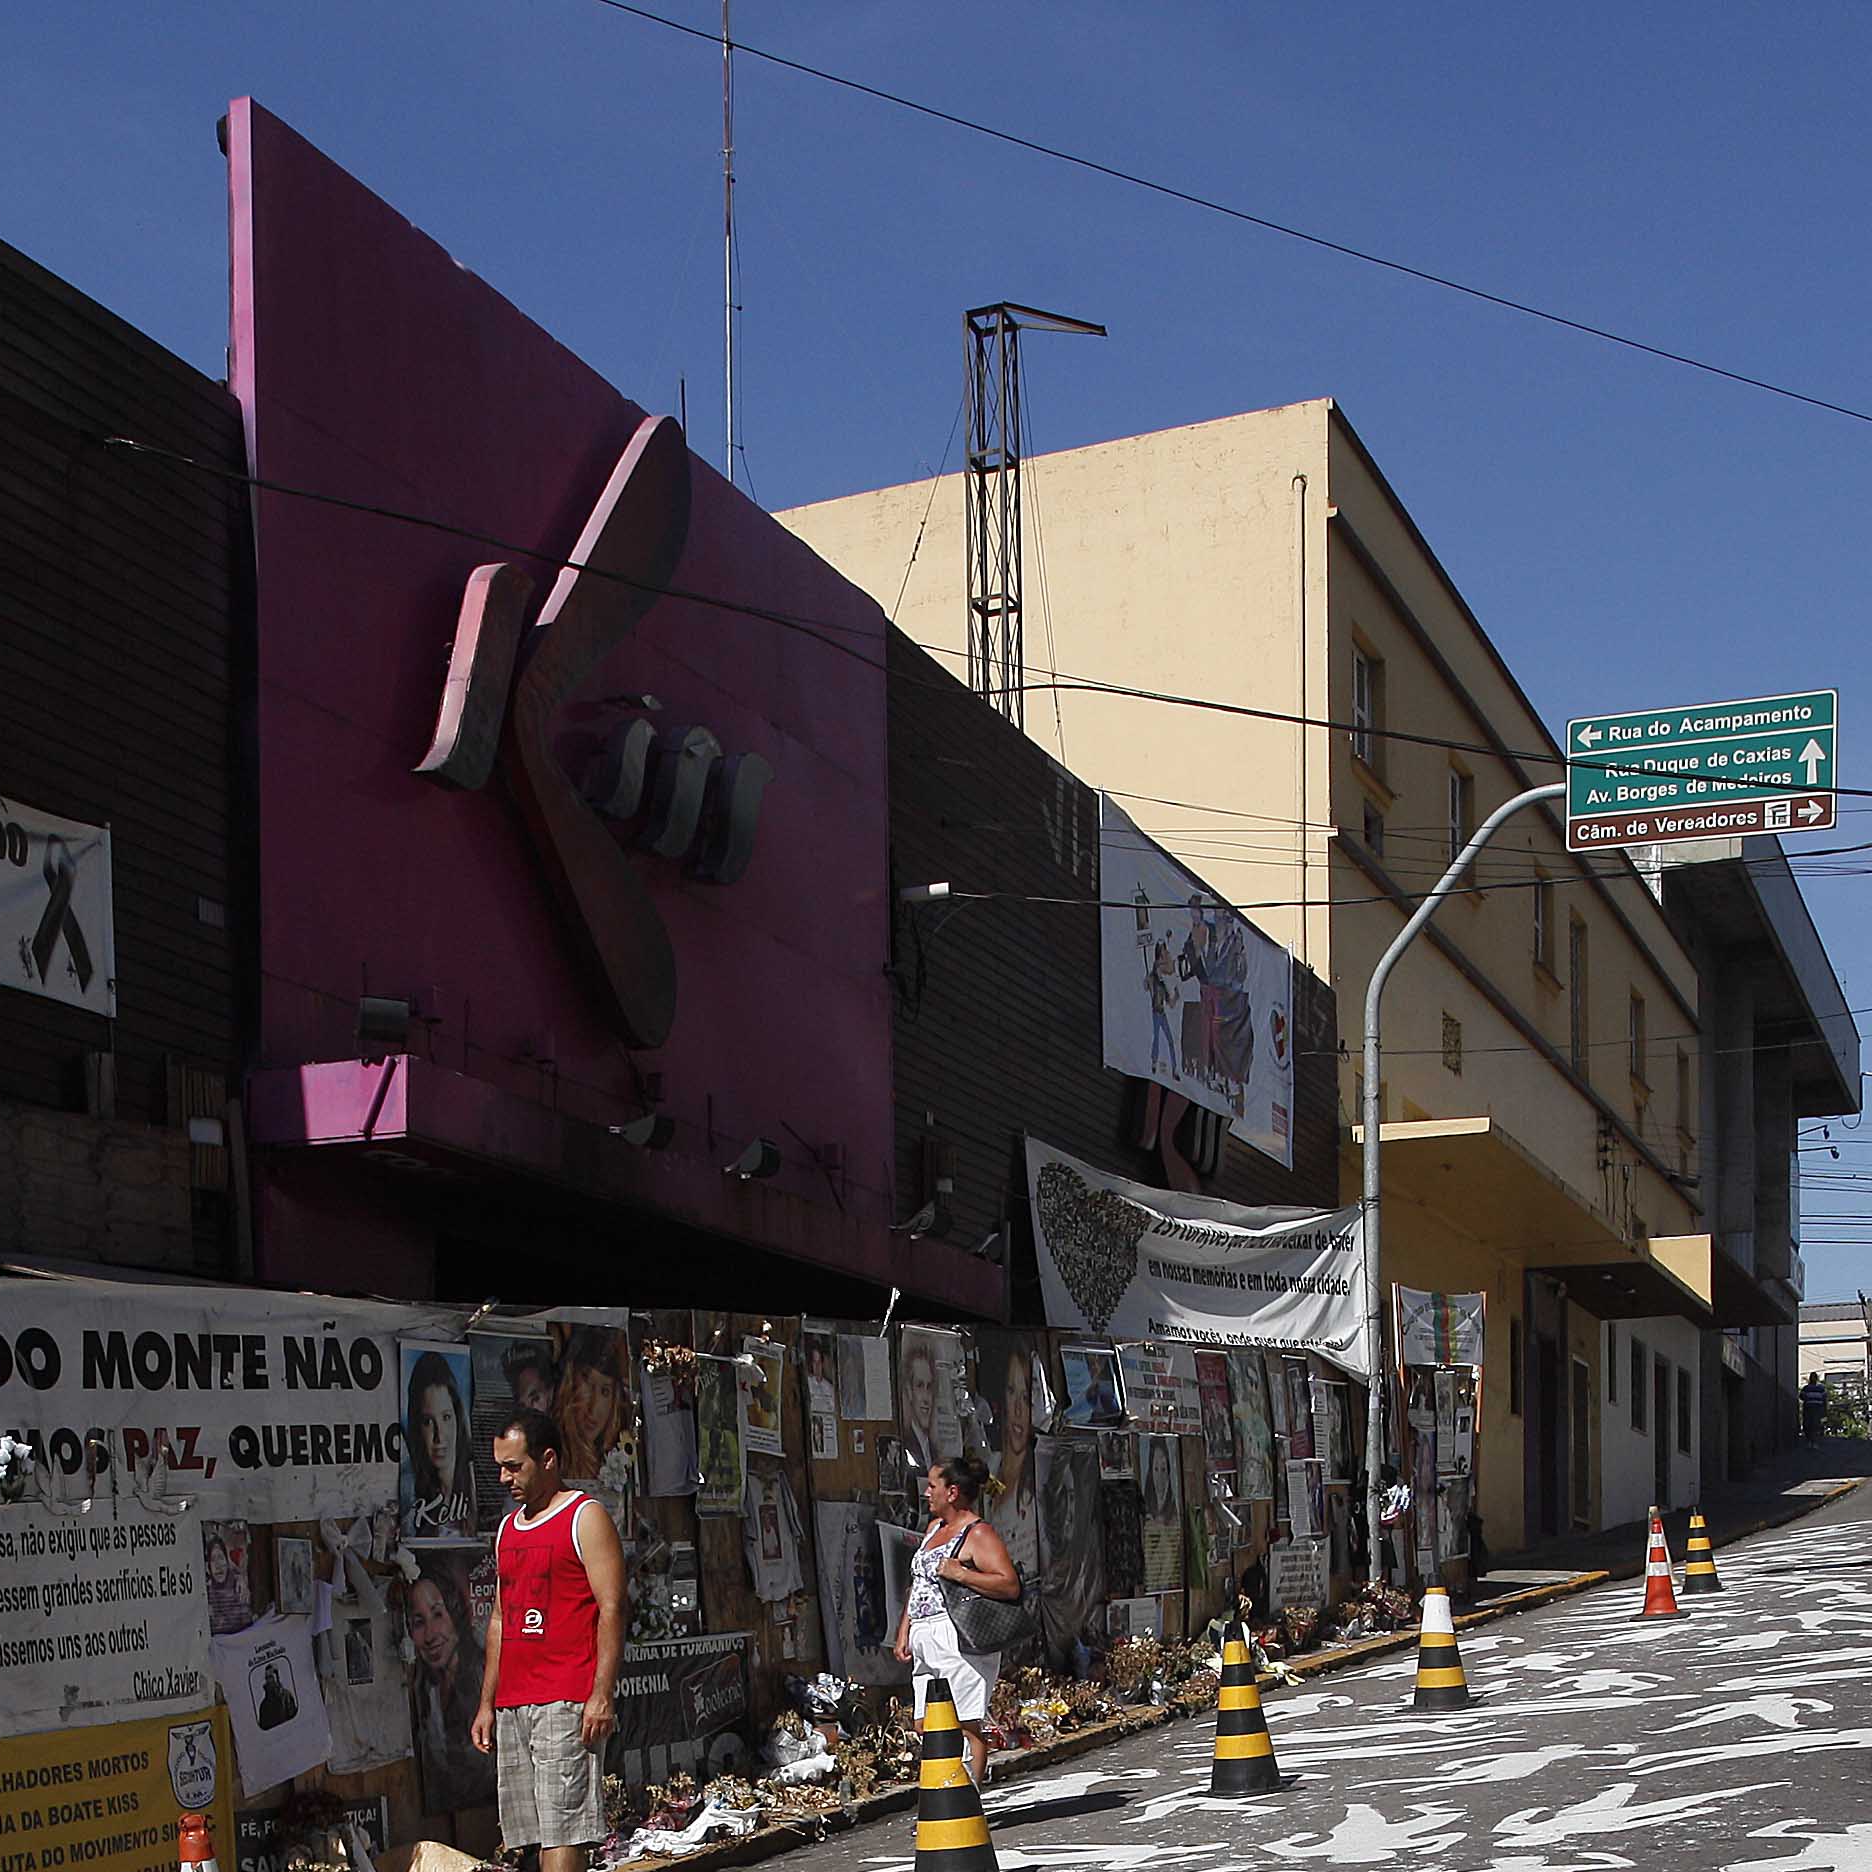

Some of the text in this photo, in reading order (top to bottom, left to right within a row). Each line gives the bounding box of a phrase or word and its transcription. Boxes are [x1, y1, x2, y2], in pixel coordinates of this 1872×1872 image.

[1609, 706, 1812, 742] Rua do Acampamento
[1605, 746, 1791, 779] Rua Duque de Caxias
[1587, 789, 1611, 804] Av.
[1617, 781, 1677, 801] Borges
[1687, 779, 1706, 794] de
[1577, 810, 1757, 841] Câm. de Vereadores
[1148, 1260, 1161, 1277] em
[1161, 1262, 1192, 1283] nossas
[1193, 1266, 1238, 1290] memórias
[1240, 1274, 1246, 1289] e
[1248, 1275, 1262, 1291] em
[1264, 1271, 1288, 1292] toda
[82, 1330, 269, 1391] MONTE
[283, 1321, 384, 1391] NÃO
[229, 1422, 400, 1469] QUEREMO
[414, 1496, 470, 1529] Kelli
[22, 1525, 45, 1556] não
[49, 1520, 86, 1563] exigiu
[89, 1527, 110, 1555] que
[113, 1525, 127, 1549] as
[129, 1523, 177, 1555] pessoas
[43, 1573, 92, 1616] grandes
[96, 1570, 158, 1604] sacrifícios.
[159, 1567, 177, 1597] Ele
[179, 1563, 193, 1595] só
[58, 1633, 82, 1659] uns
[84, 1631, 107, 1656] aos
[109, 1620, 150, 1651] outros!
[133, 1668, 200, 1699] Chico Xavier
[88, 1751, 150, 1779] MORTOS
[21, 1808, 44, 1832] DA
[48, 1798, 103, 1829] BOATE
[106, 1791, 138, 1815] KISS
[41, 1844, 65, 1868] DO
[69, 1827, 158, 1863] MOVIMENTO
